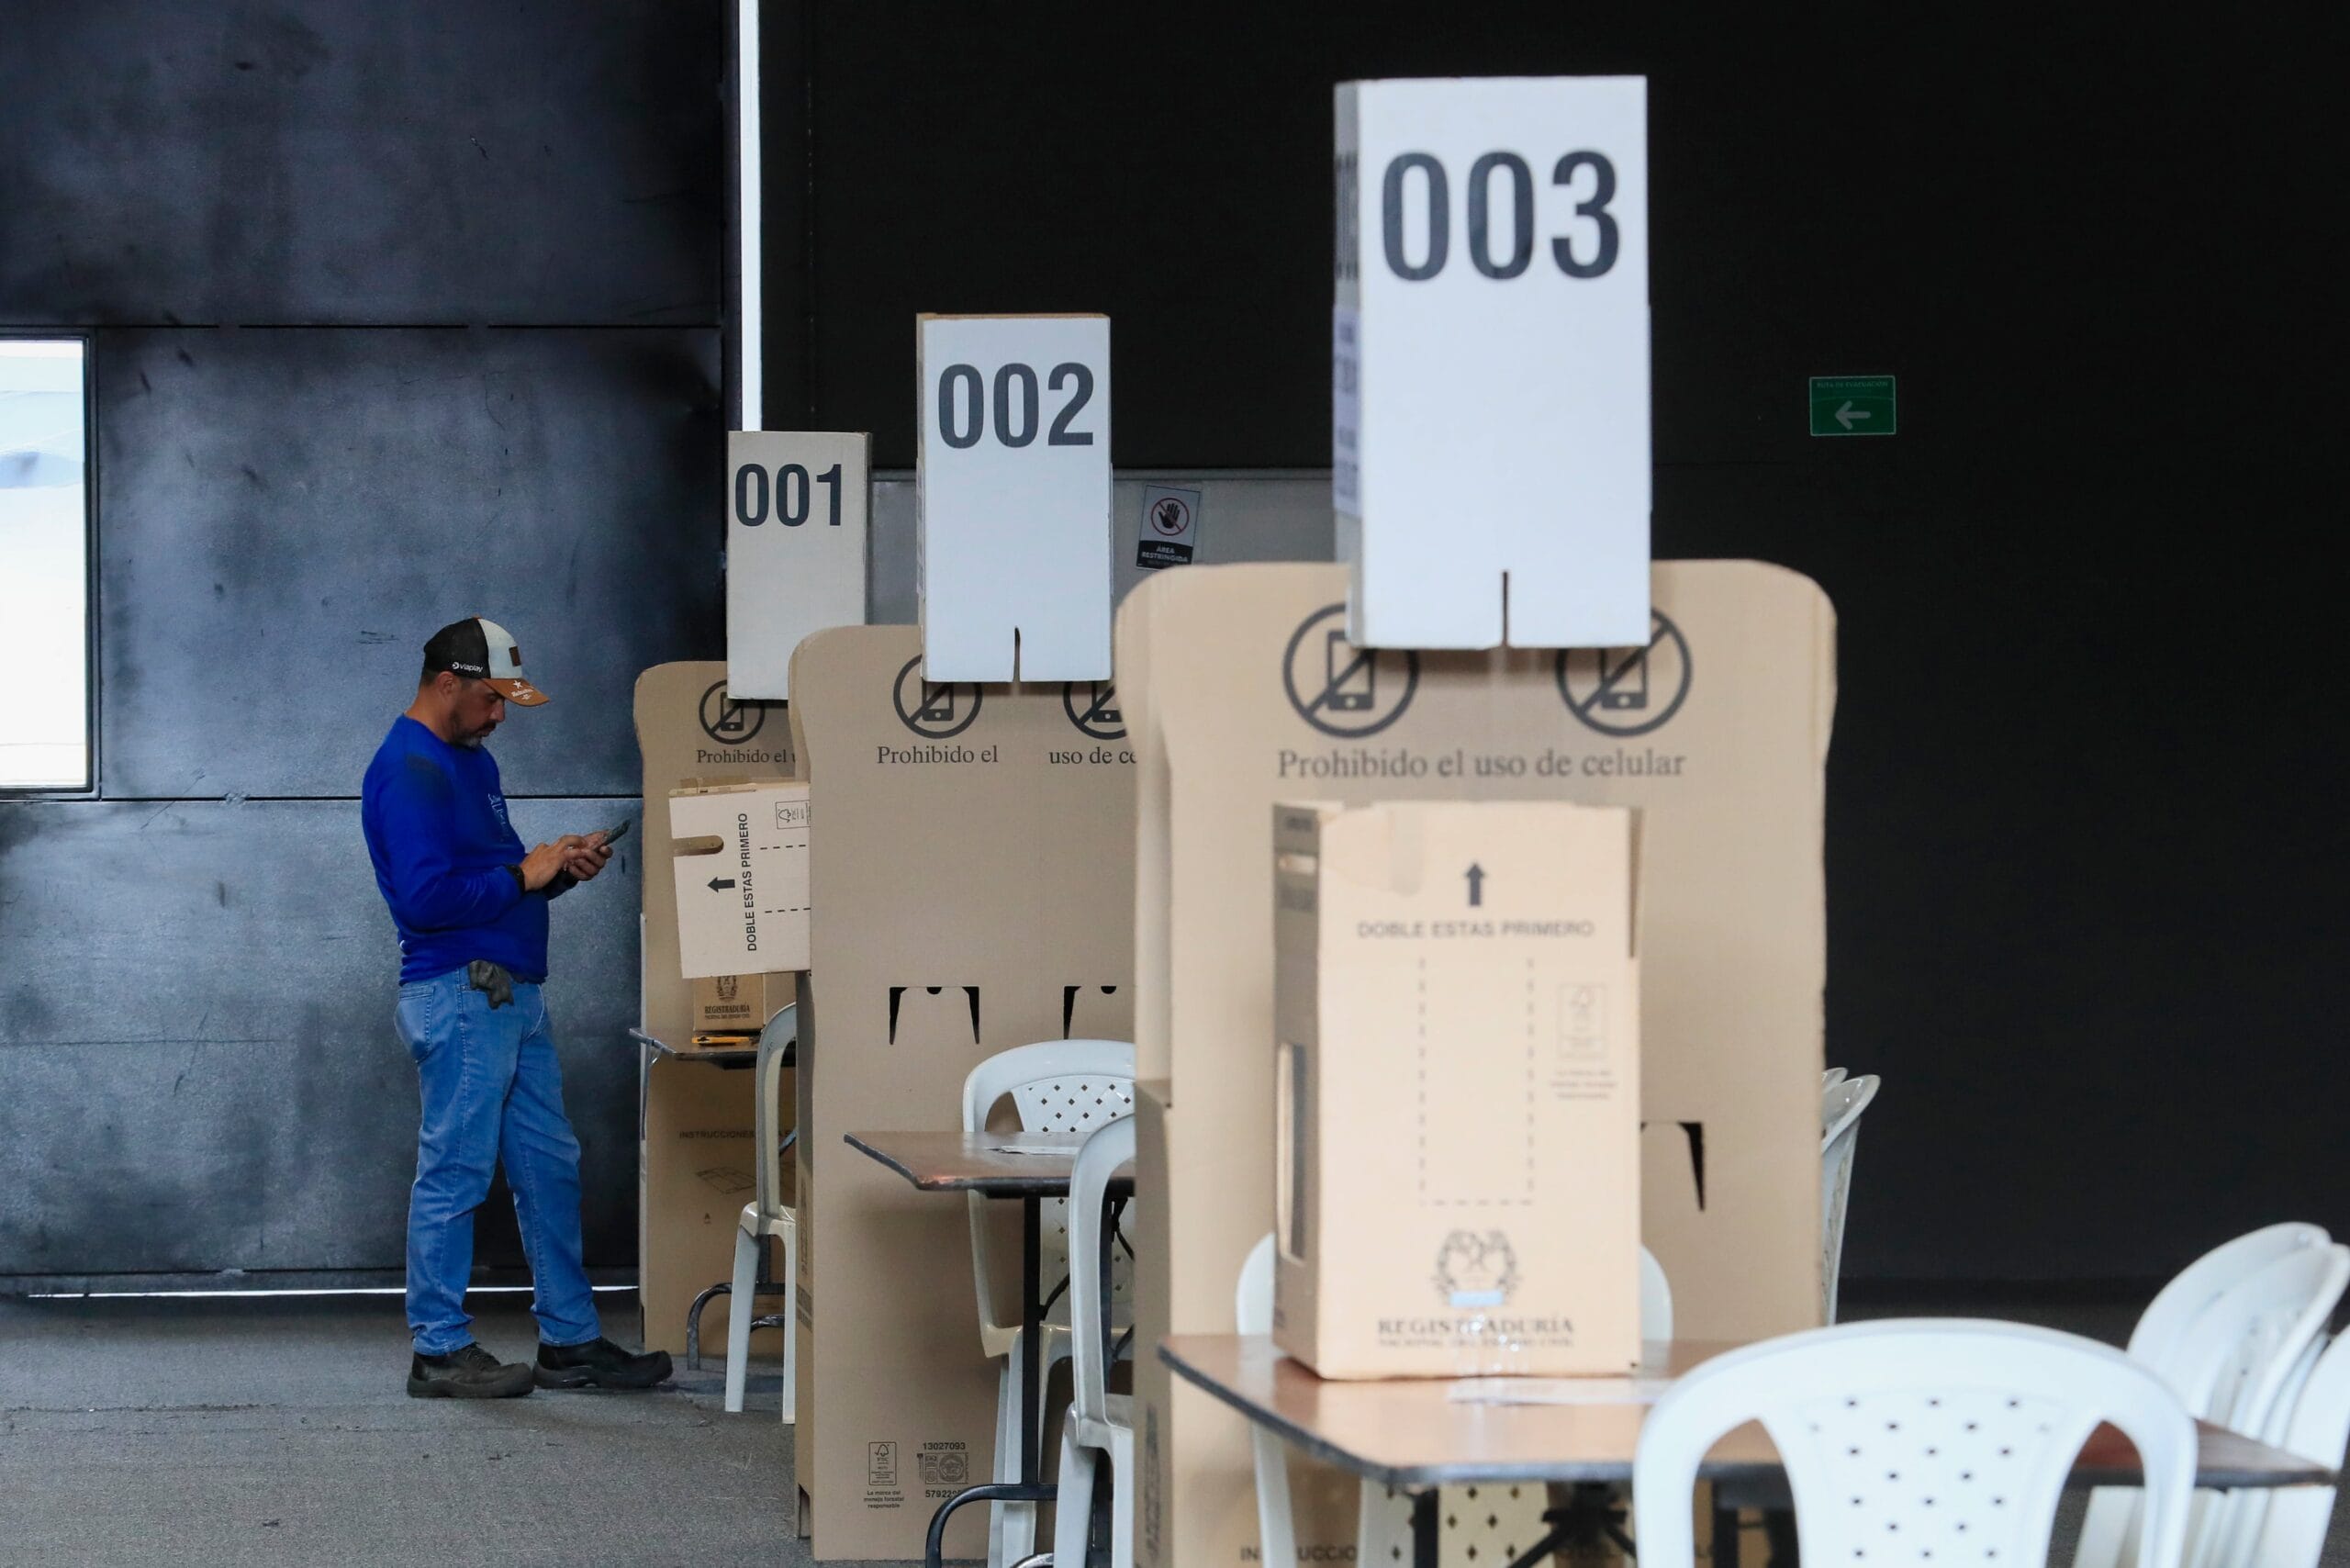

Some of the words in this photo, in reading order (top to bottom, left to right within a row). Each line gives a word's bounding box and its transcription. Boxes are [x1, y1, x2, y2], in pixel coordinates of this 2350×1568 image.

[1381, 150, 1621, 281] 003
[937, 362, 1094, 449] 002
[734, 463, 843, 527] 001
[459, 663, 483, 673] viaplay
[696, 749, 770, 764] Prohibido
[774, 749, 788, 764] el
[877, 745, 975, 764] Prohibido
[980, 745, 999, 764] el
[1049, 749, 1083, 765] uso
[1089, 746, 1113, 765] de
[1277, 748, 1428, 779] Prohibido
[1437, 748, 1464, 778] el
[1474, 752, 1528, 778] uso
[1535, 748, 1572, 778] de
[1581, 746, 1687, 777] celular
[737, 812, 751, 868] PRIMERO
[742, 870, 755, 908] ESTAS
[745, 911, 757, 951] DOBLE
[1357, 920, 1423, 938] DOBLE
[1430, 920, 1494, 938] ESTAS
[1501, 920, 1595, 938] PRIMERO
[923, 1441, 966, 1450] 13027093
